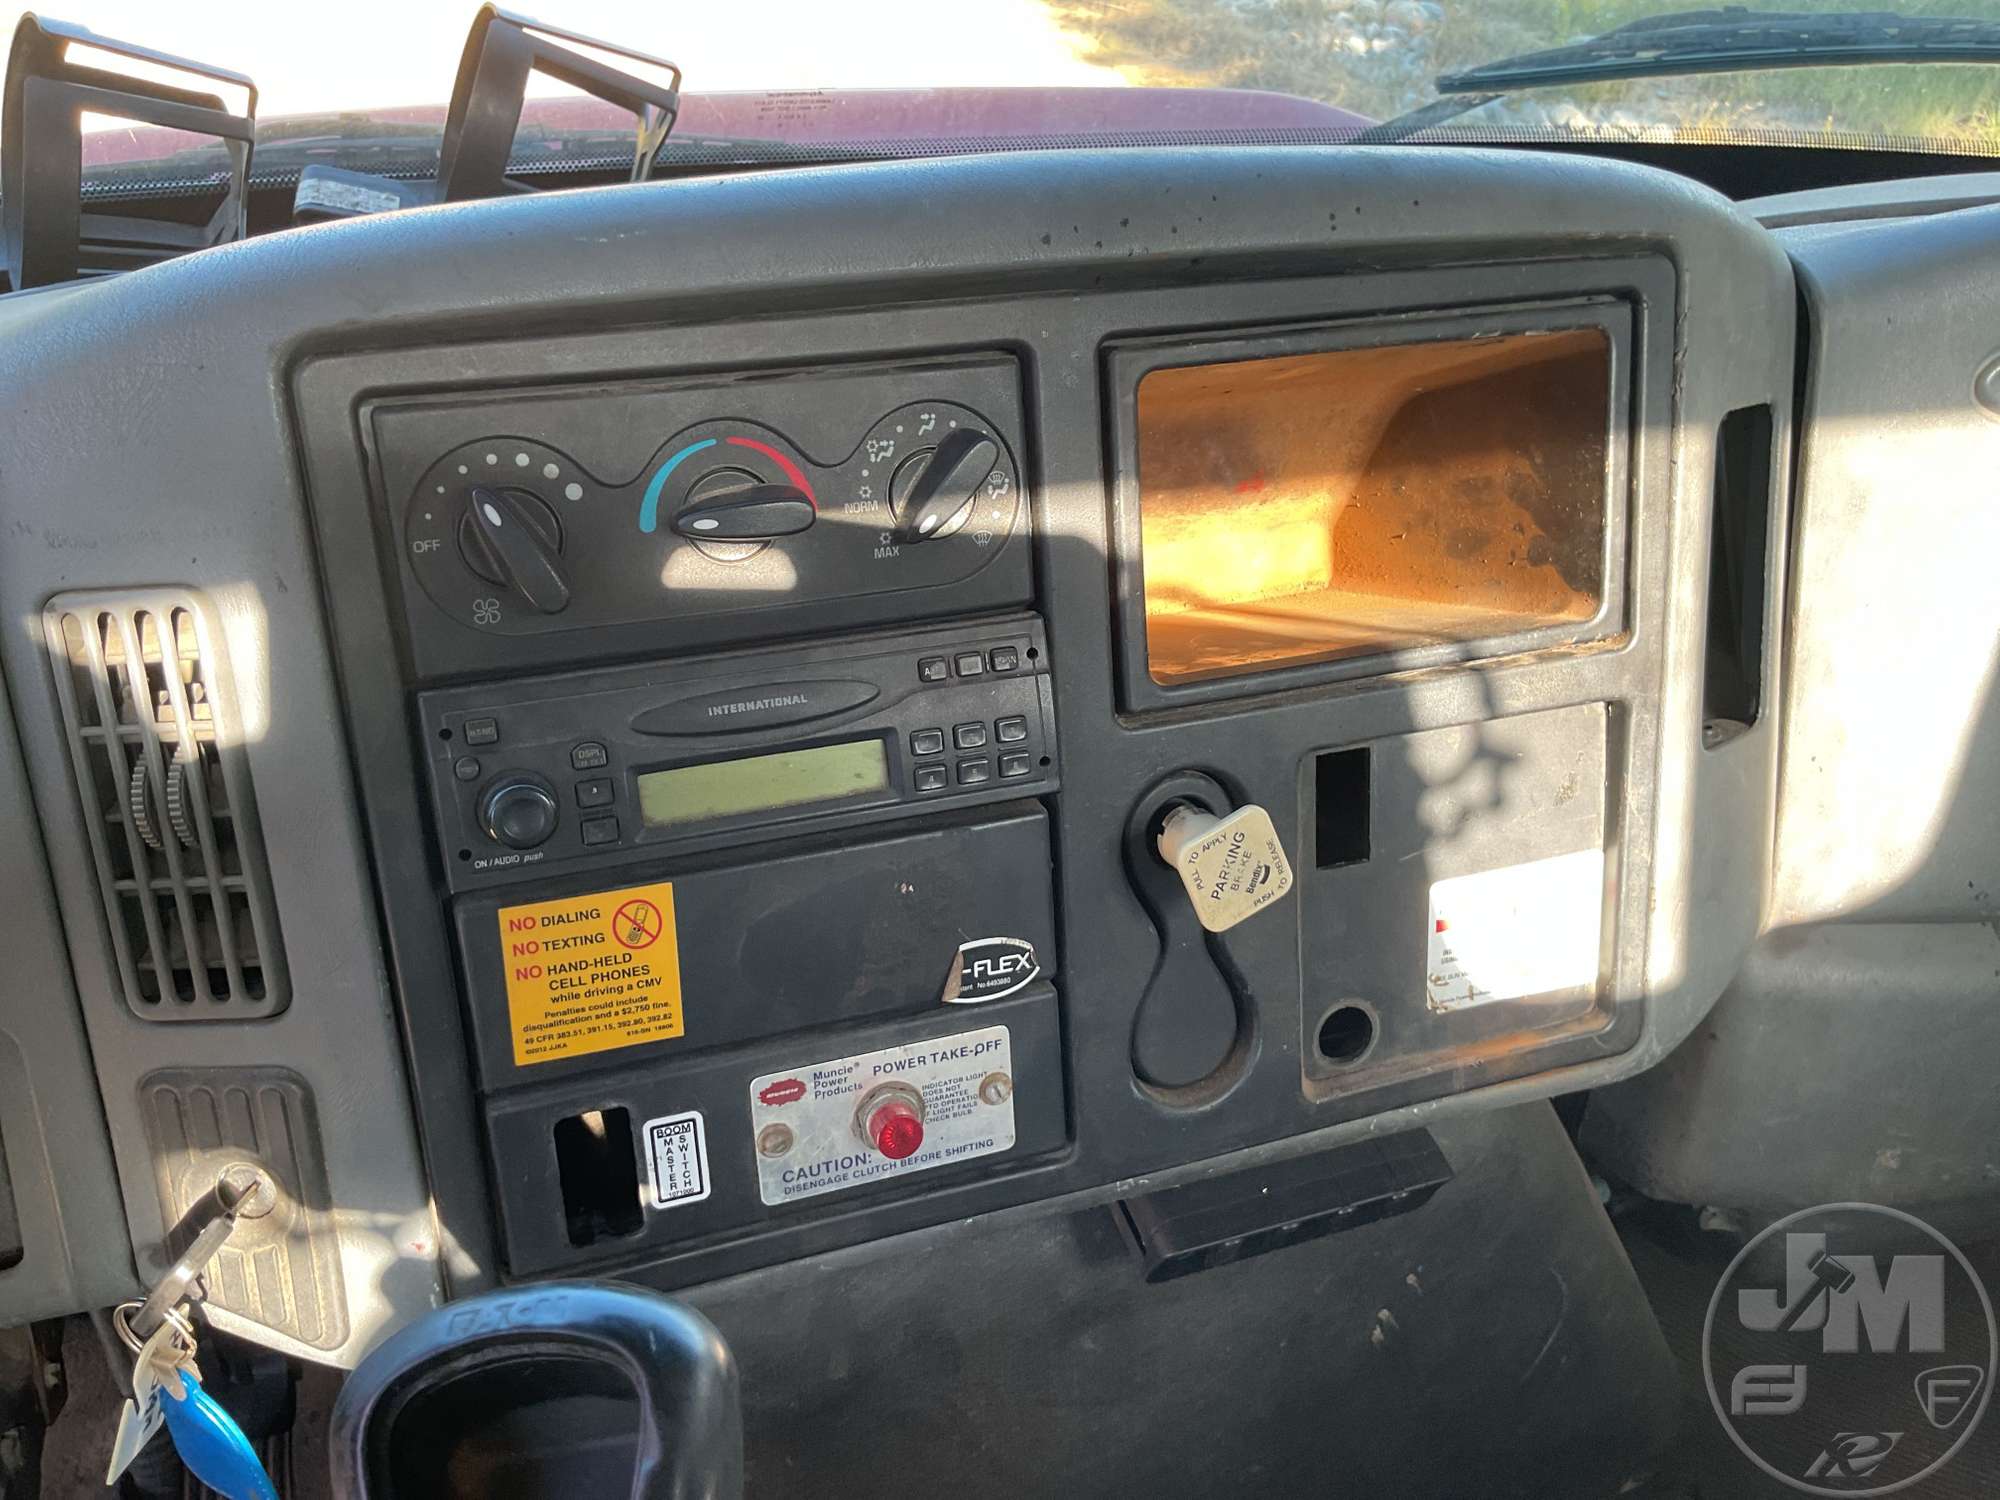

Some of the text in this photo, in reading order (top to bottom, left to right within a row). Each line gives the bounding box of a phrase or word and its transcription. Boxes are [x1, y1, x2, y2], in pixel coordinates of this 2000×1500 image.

[844, 500, 879, 514] NORM
[413, 540, 440, 552] OFF
[874, 546, 900, 559] MAX
[708, 694, 808, 716] INTERNATIONAL
[474, 860, 488, 869] ON
[524, 852, 544, 863] push
[1188, 851, 1199, 865] TO
[1202, 832, 1228, 853] APPLY
[1211, 831, 1246, 900] PARKING
[1253, 839, 1288, 907] PUSH TO RELEASE
[1246, 863, 1264, 894] Bendix
[509, 908, 601, 932] NO DIALING
[512, 932, 606, 957] NO TEXTING
[515, 952, 633, 981] NO HAND-HELD
[548, 964, 650, 991] CELL PHONES
[550, 977, 662, 1004] while driving a CMV
[523, 1014, 593, 1033] disqualification
[595, 1010, 612, 1020] and
[621, 1004, 650, 1016] $2,750
[652, 1001, 671, 1010] fine.
[544, 995, 648, 1019] Penalties could include
[524, 1036, 535, 1045] 49
[536, 1033, 555, 1044] CFR
[873, 1039, 1003, 1076] POWER TAKE-OFF
[814, 1076, 849, 1089] Power
[815, 1083, 863, 1100] Products
[922, 1077, 964, 1091] INDICATOR
[923, 1084, 961, 1097] DOES NOT
[924, 1114, 950, 1125] CHECK
[933, 1106, 955, 1116] LIGHT
[656, 1123, 691, 1139] BOOM
[664, 1138, 678, 1191] MASTER
[678, 1135, 692, 1187] SWITCH
[782, 1152, 872, 1183] CAUTION:
[784, 1139, 994, 1195] DISENGAGE CLUTCH BEFORE SHIFTING
